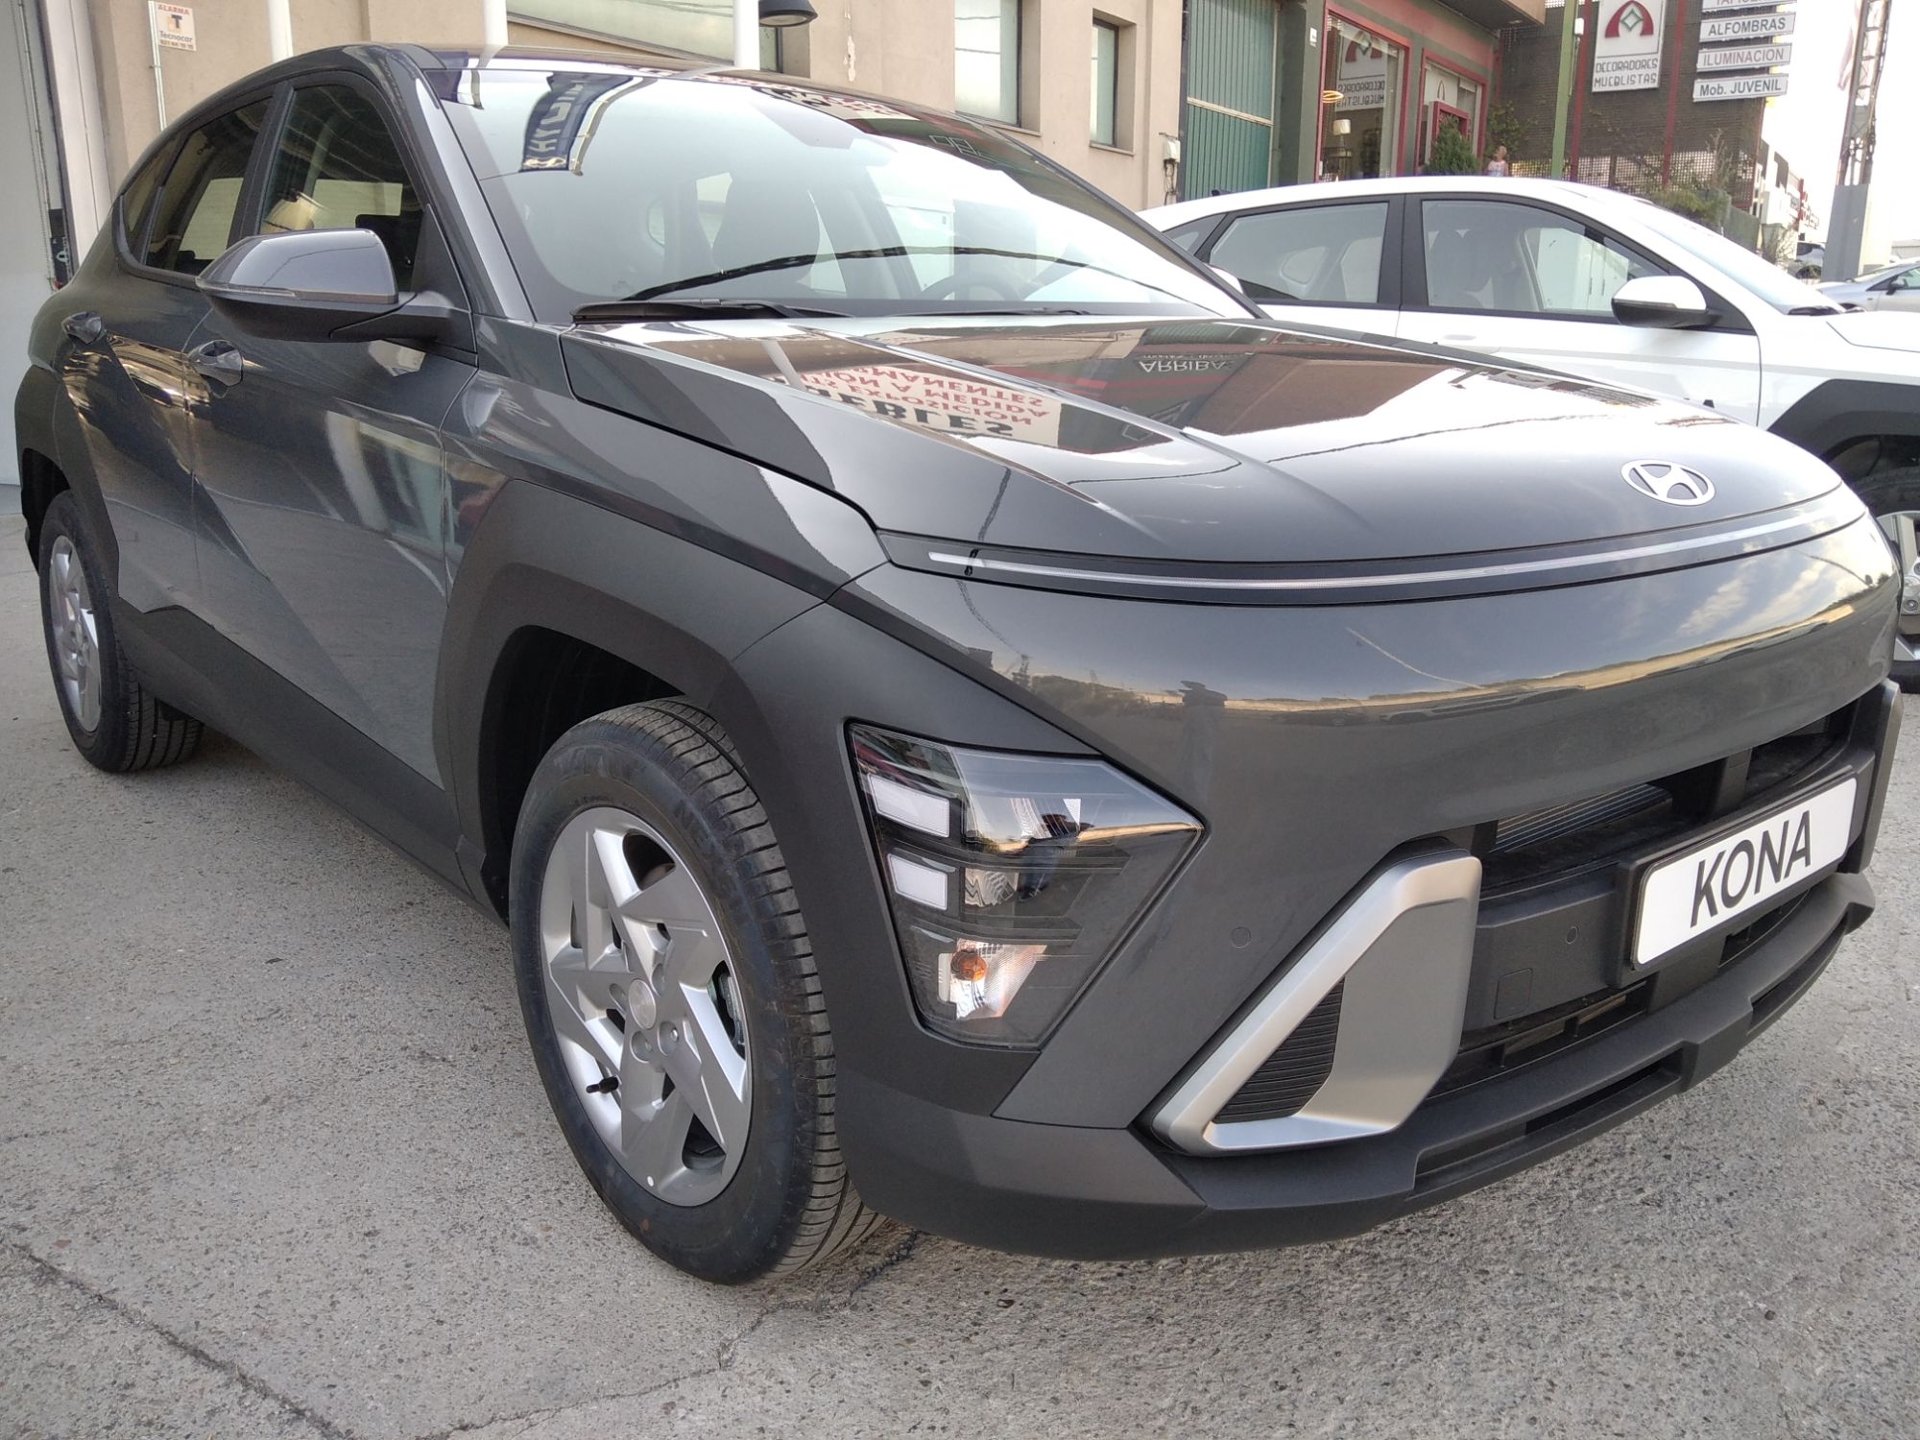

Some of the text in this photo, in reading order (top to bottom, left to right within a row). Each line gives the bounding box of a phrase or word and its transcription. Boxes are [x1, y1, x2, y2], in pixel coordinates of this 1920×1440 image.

[158, 4, 190, 15] ALARMA
[1708, 17, 1786, 36] ALFOMBRAS
[1595, 58, 1659, 73] DECORADORES
[1703, 48, 1784, 66] ILUMINACION
[1593, 73, 1658, 88] MUEBLISTAS
[1699, 79, 1782, 97] Mob. JUVENIL
[1690, 810, 1811, 928] KONA
